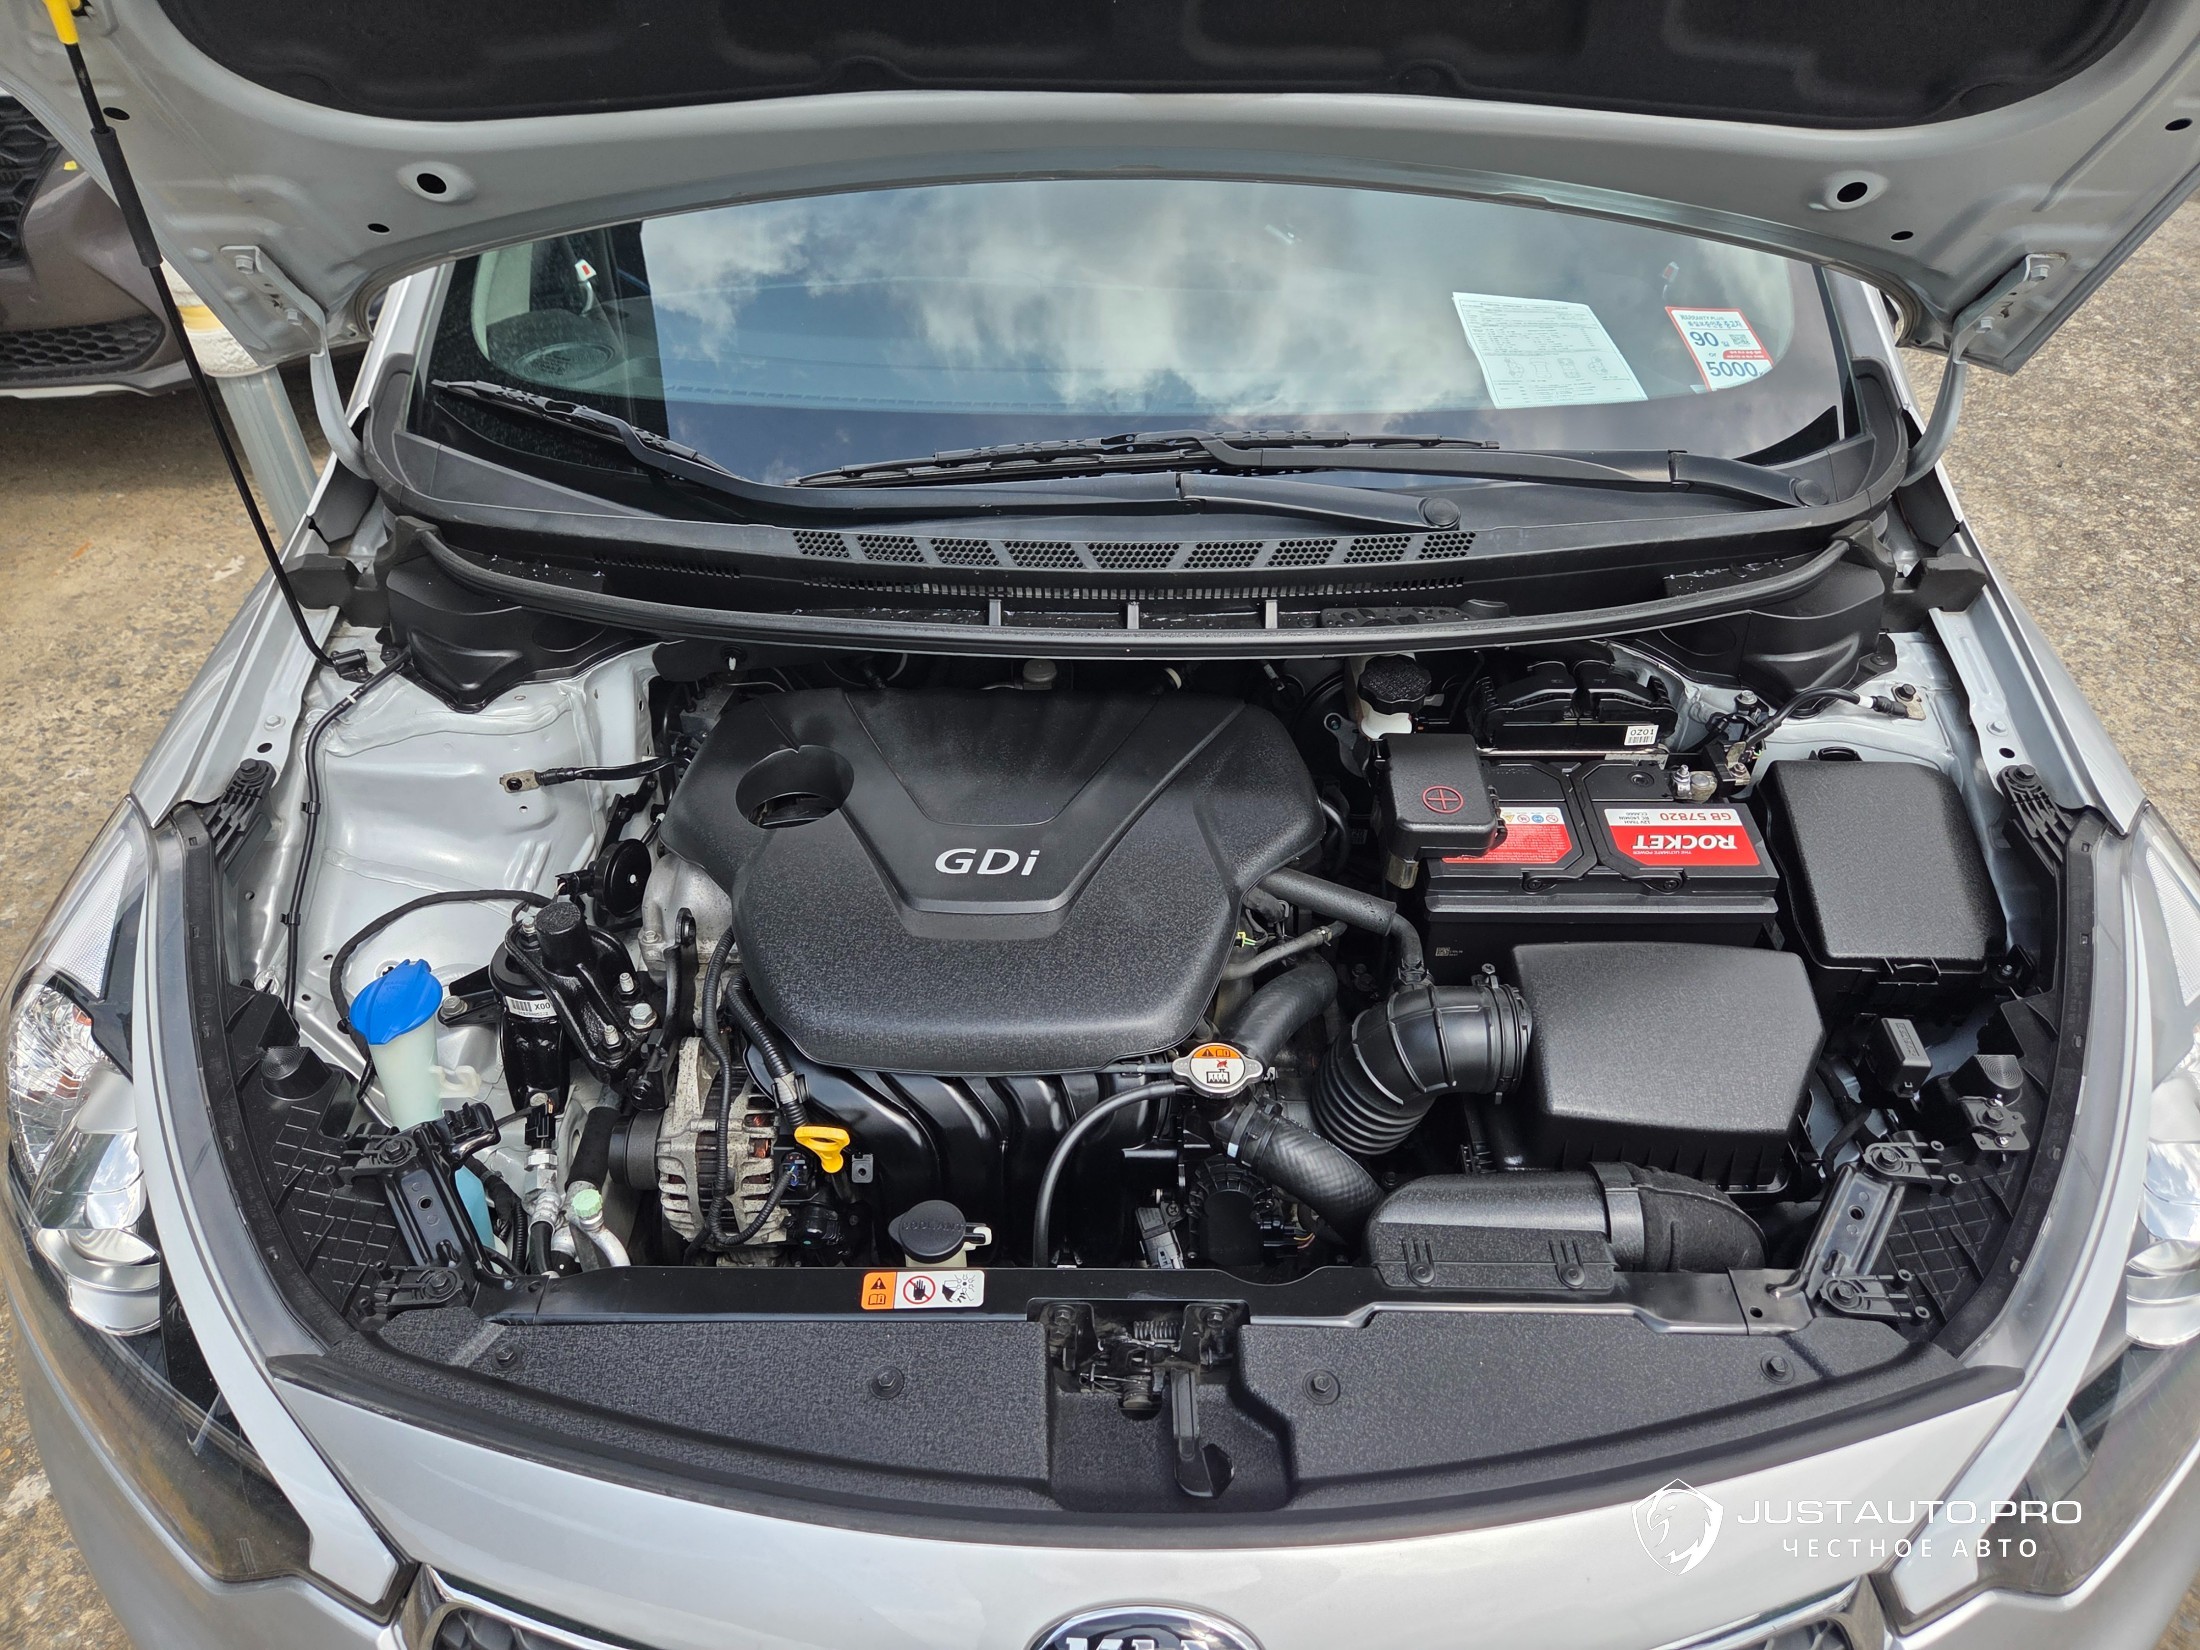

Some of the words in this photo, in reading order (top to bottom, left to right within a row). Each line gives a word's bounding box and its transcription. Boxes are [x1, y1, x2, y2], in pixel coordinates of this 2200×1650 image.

[1690, 331, 1719, 347] 90
[1705, 361, 1758, 377] 5000
[1659, 813, 1706, 821] 57820
[1711, 813, 1732, 821] GB
[1632, 834, 1738, 850] ROCKET
[935, 848, 1040, 876] GDi
[534, 1002, 551, 1010] X00
